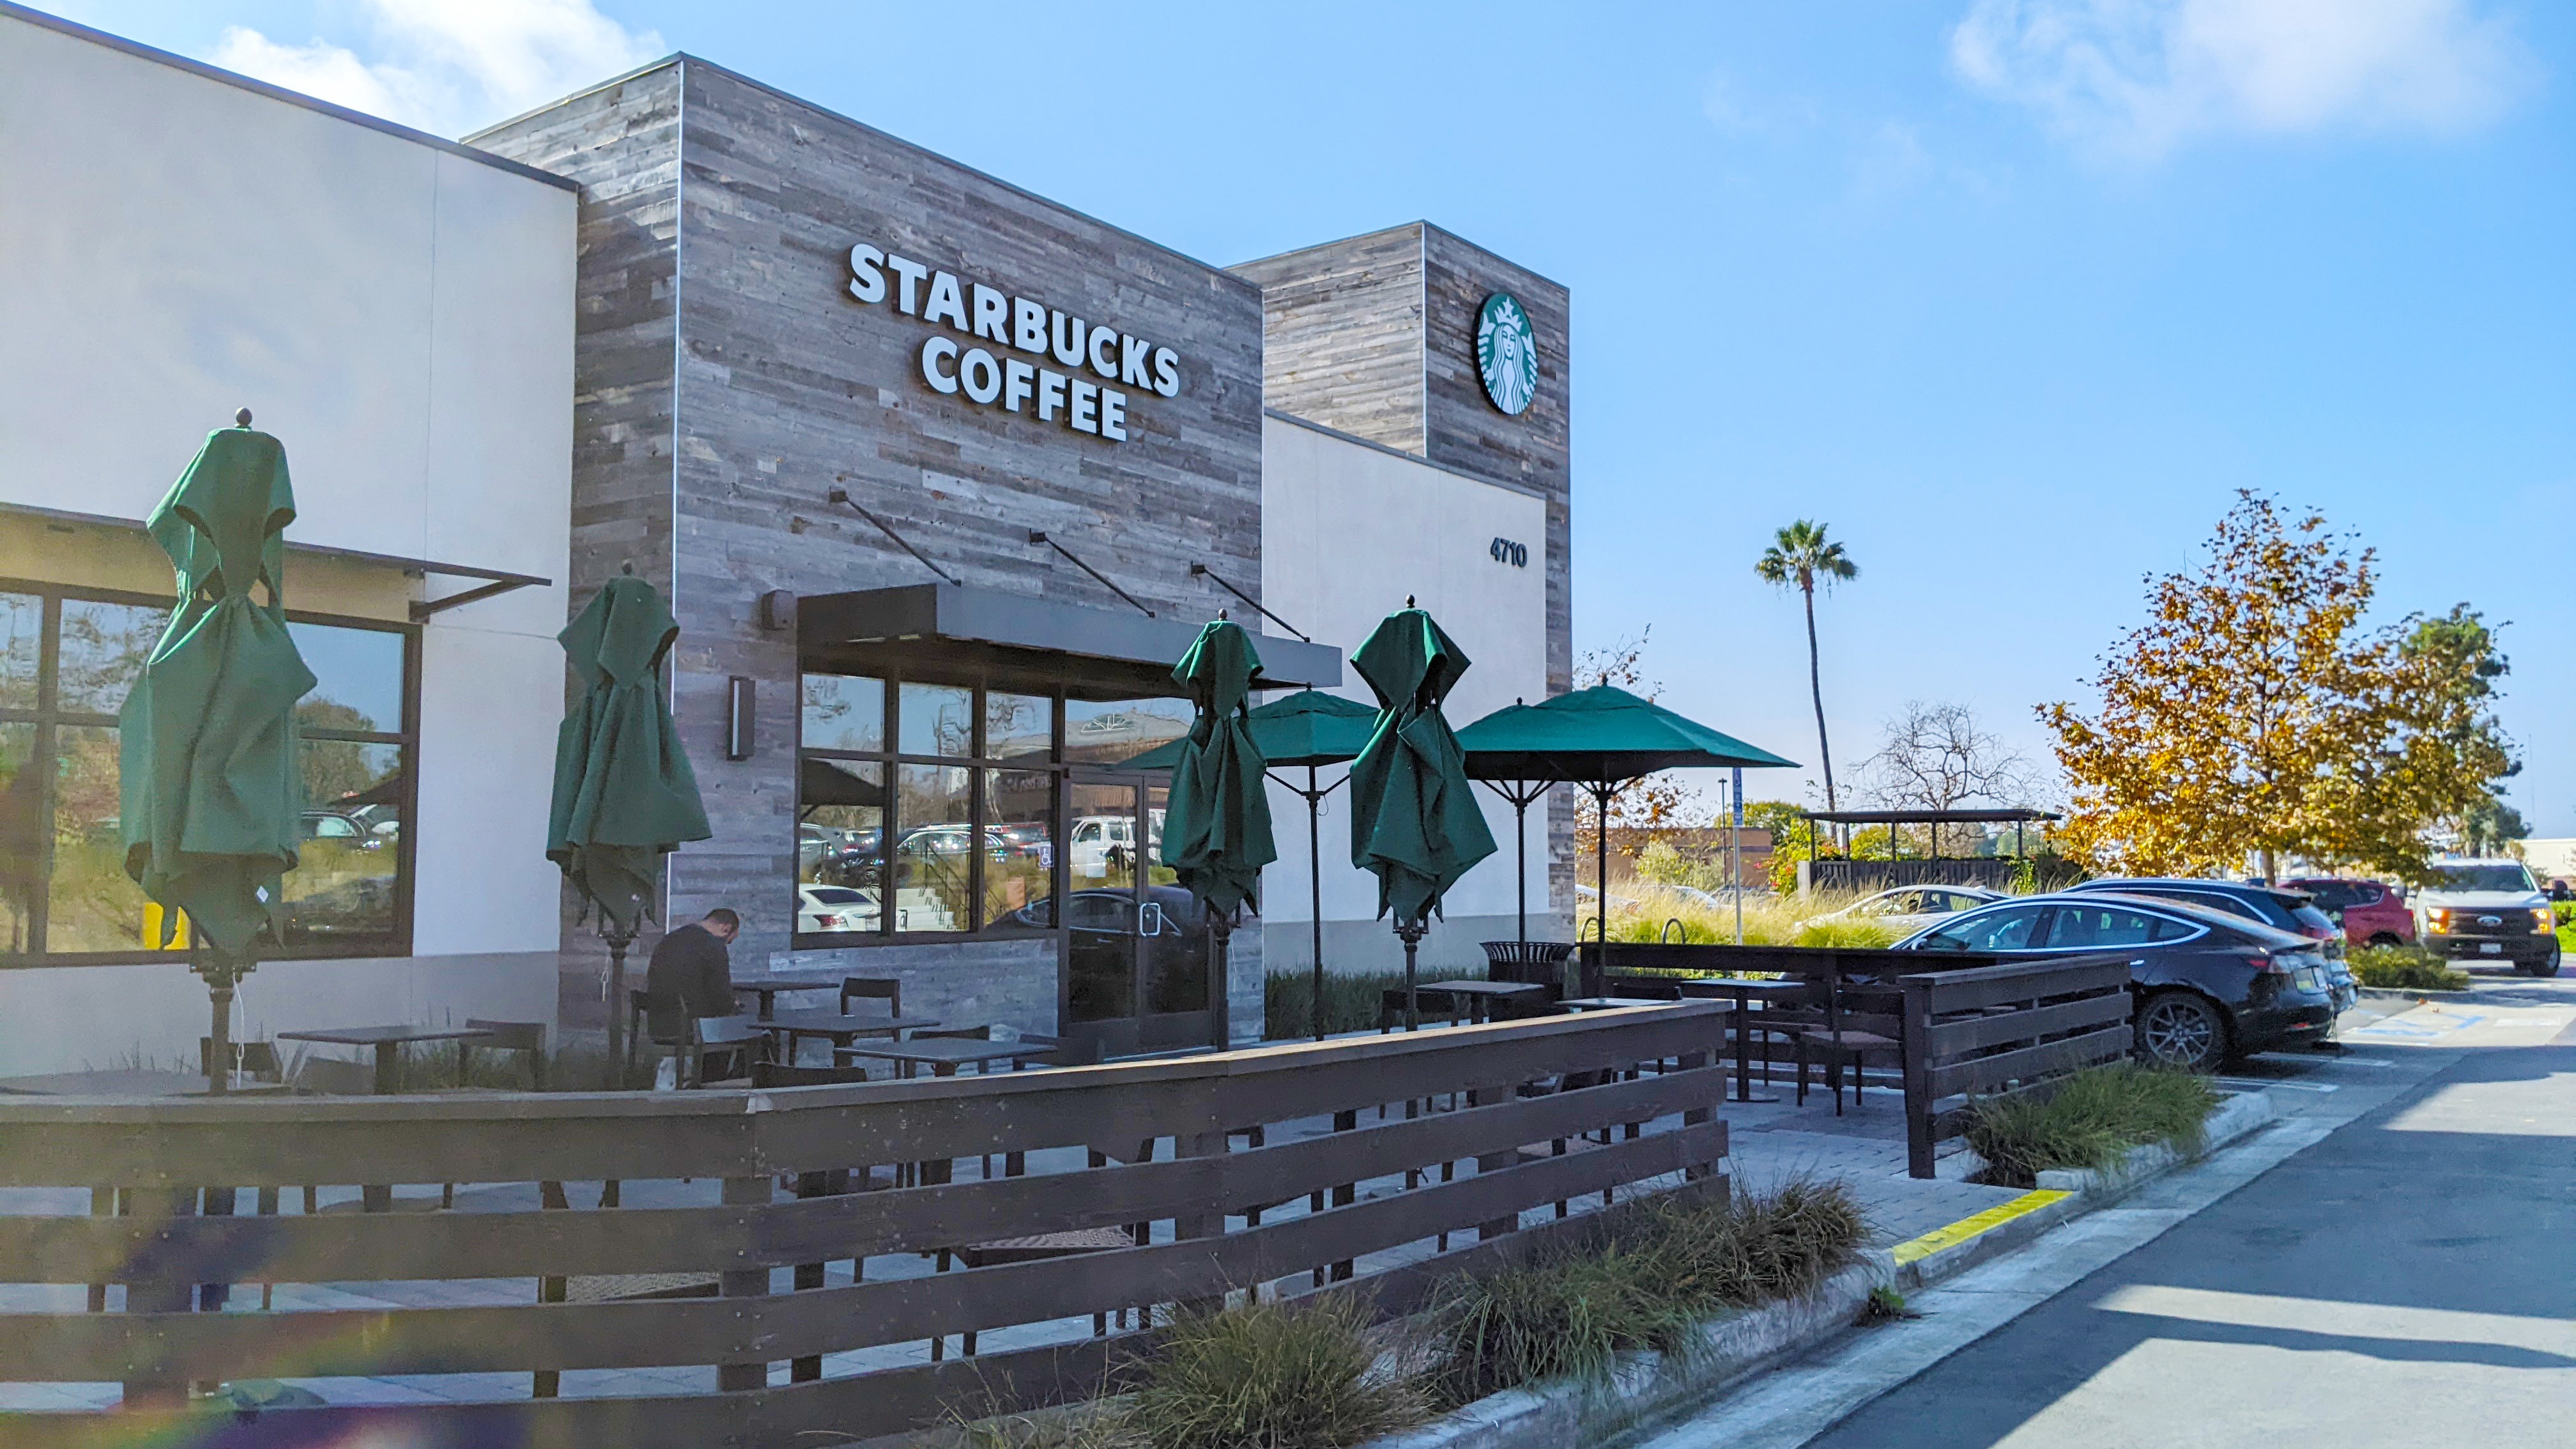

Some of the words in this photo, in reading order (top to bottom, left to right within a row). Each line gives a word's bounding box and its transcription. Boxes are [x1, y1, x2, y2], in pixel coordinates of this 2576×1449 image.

[848, 243, 1180, 398] STARBUCKS
[922, 336, 1126, 441] COFFEE
[1490, 537, 1528, 567] 4710
